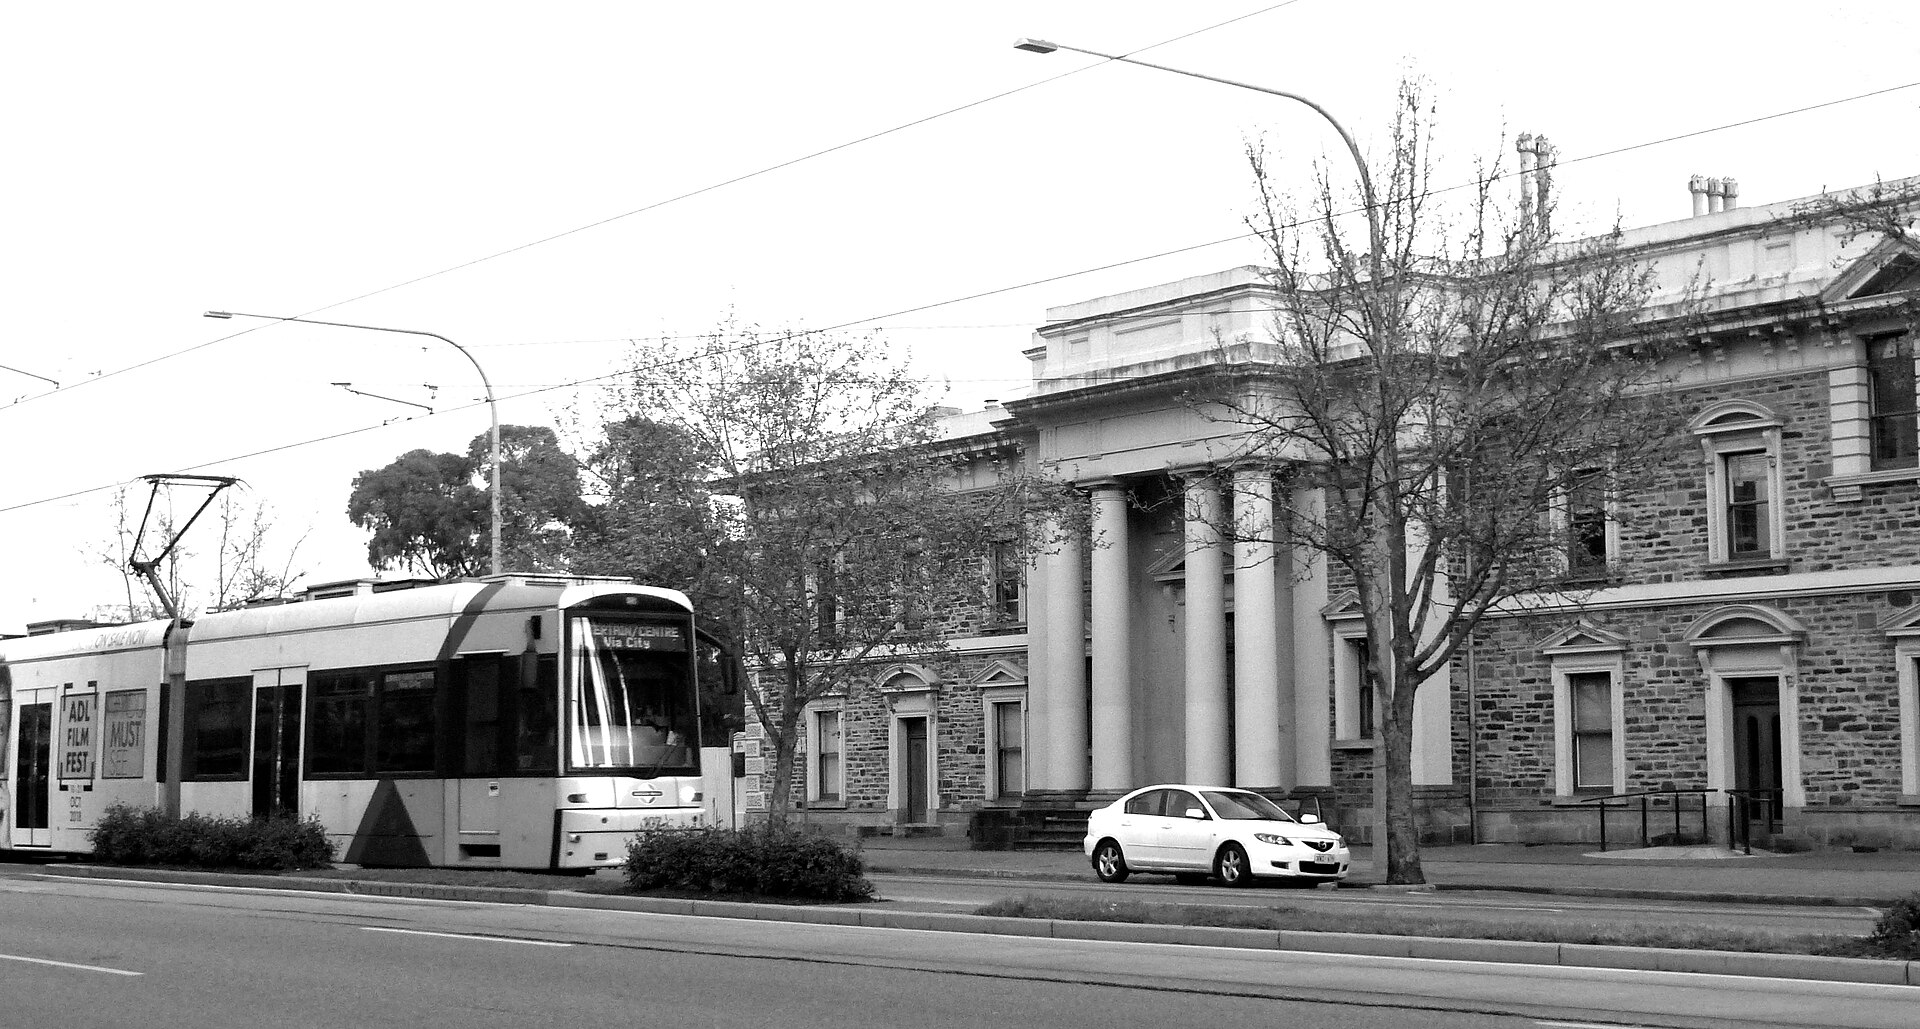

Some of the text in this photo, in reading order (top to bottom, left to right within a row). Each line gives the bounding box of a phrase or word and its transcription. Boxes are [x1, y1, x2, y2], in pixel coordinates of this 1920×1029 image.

[603, 636, 650, 650] Via City
[69, 699, 90, 723] ADL
[67, 727, 89, 747] FILM
[109, 720, 141, 747] MUST
[66, 751, 89, 773] FEST
